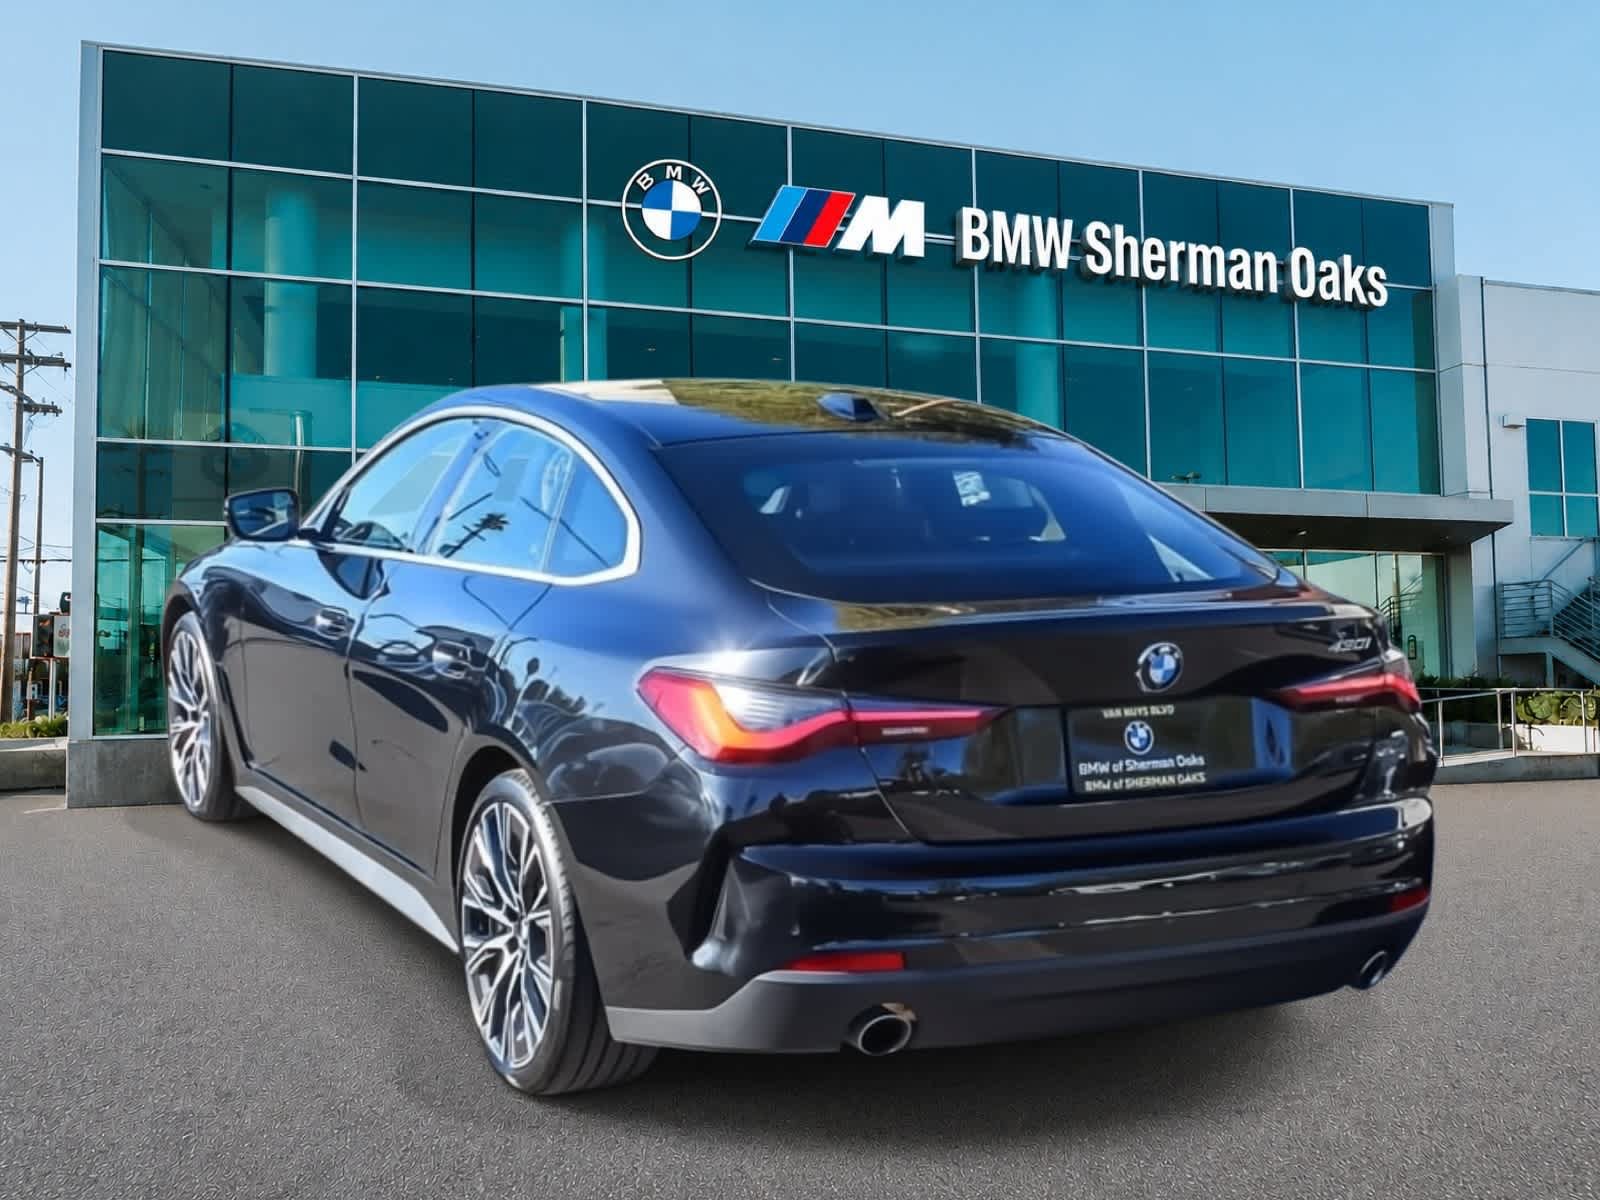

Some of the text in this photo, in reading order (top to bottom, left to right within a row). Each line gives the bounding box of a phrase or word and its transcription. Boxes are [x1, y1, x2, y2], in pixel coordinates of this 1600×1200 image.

[636, 165, 711, 195] BMW
[961, 206, 1388, 308] BMW Sherman Oaks
[1150, 704, 1175, 715] BLVD
[1079, 754, 1205, 776] BMW of Sherman Oaks
[1085, 771, 1207, 792] BMW of SHERMAN OAKS
